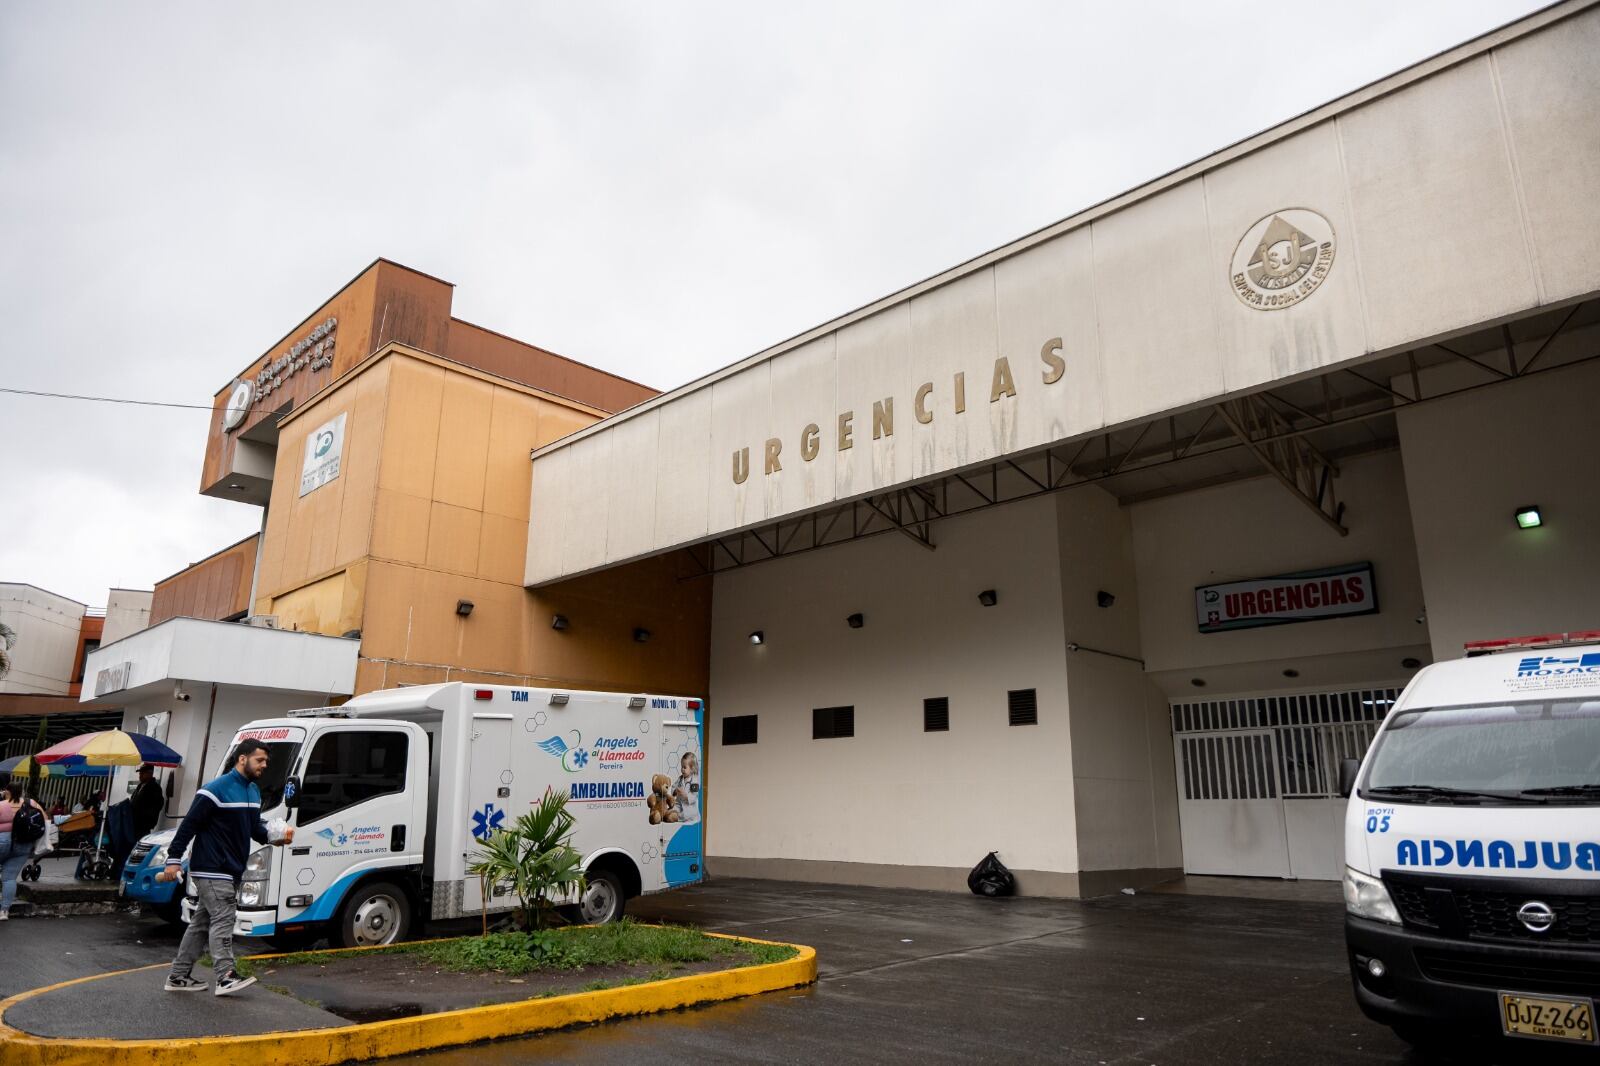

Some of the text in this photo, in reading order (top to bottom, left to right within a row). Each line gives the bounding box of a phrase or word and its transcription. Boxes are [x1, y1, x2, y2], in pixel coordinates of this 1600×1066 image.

[1233, 241, 1332, 306] EMPRESA SOCIAL DEL ESTADO
[732, 336, 1066, 485] URGENCIAS
[1224, 576, 1365, 618] URGENCIAS
[511, 691, 529, 702] TAM
[669, 699, 677, 710] 10
[594, 736, 639, 750] Angeles
[599, 750, 645, 761] Llamado
[599, 762, 624, 770] Pereira
[570, 782, 645, 799] AMBULANCIA
[351, 825, 380, 834] Angeles
[1366, 815, 1391, 833] 05
[354, 832, 385, 841] Llamado
[1532, 1026, 1567, 1036] CARTAGO
